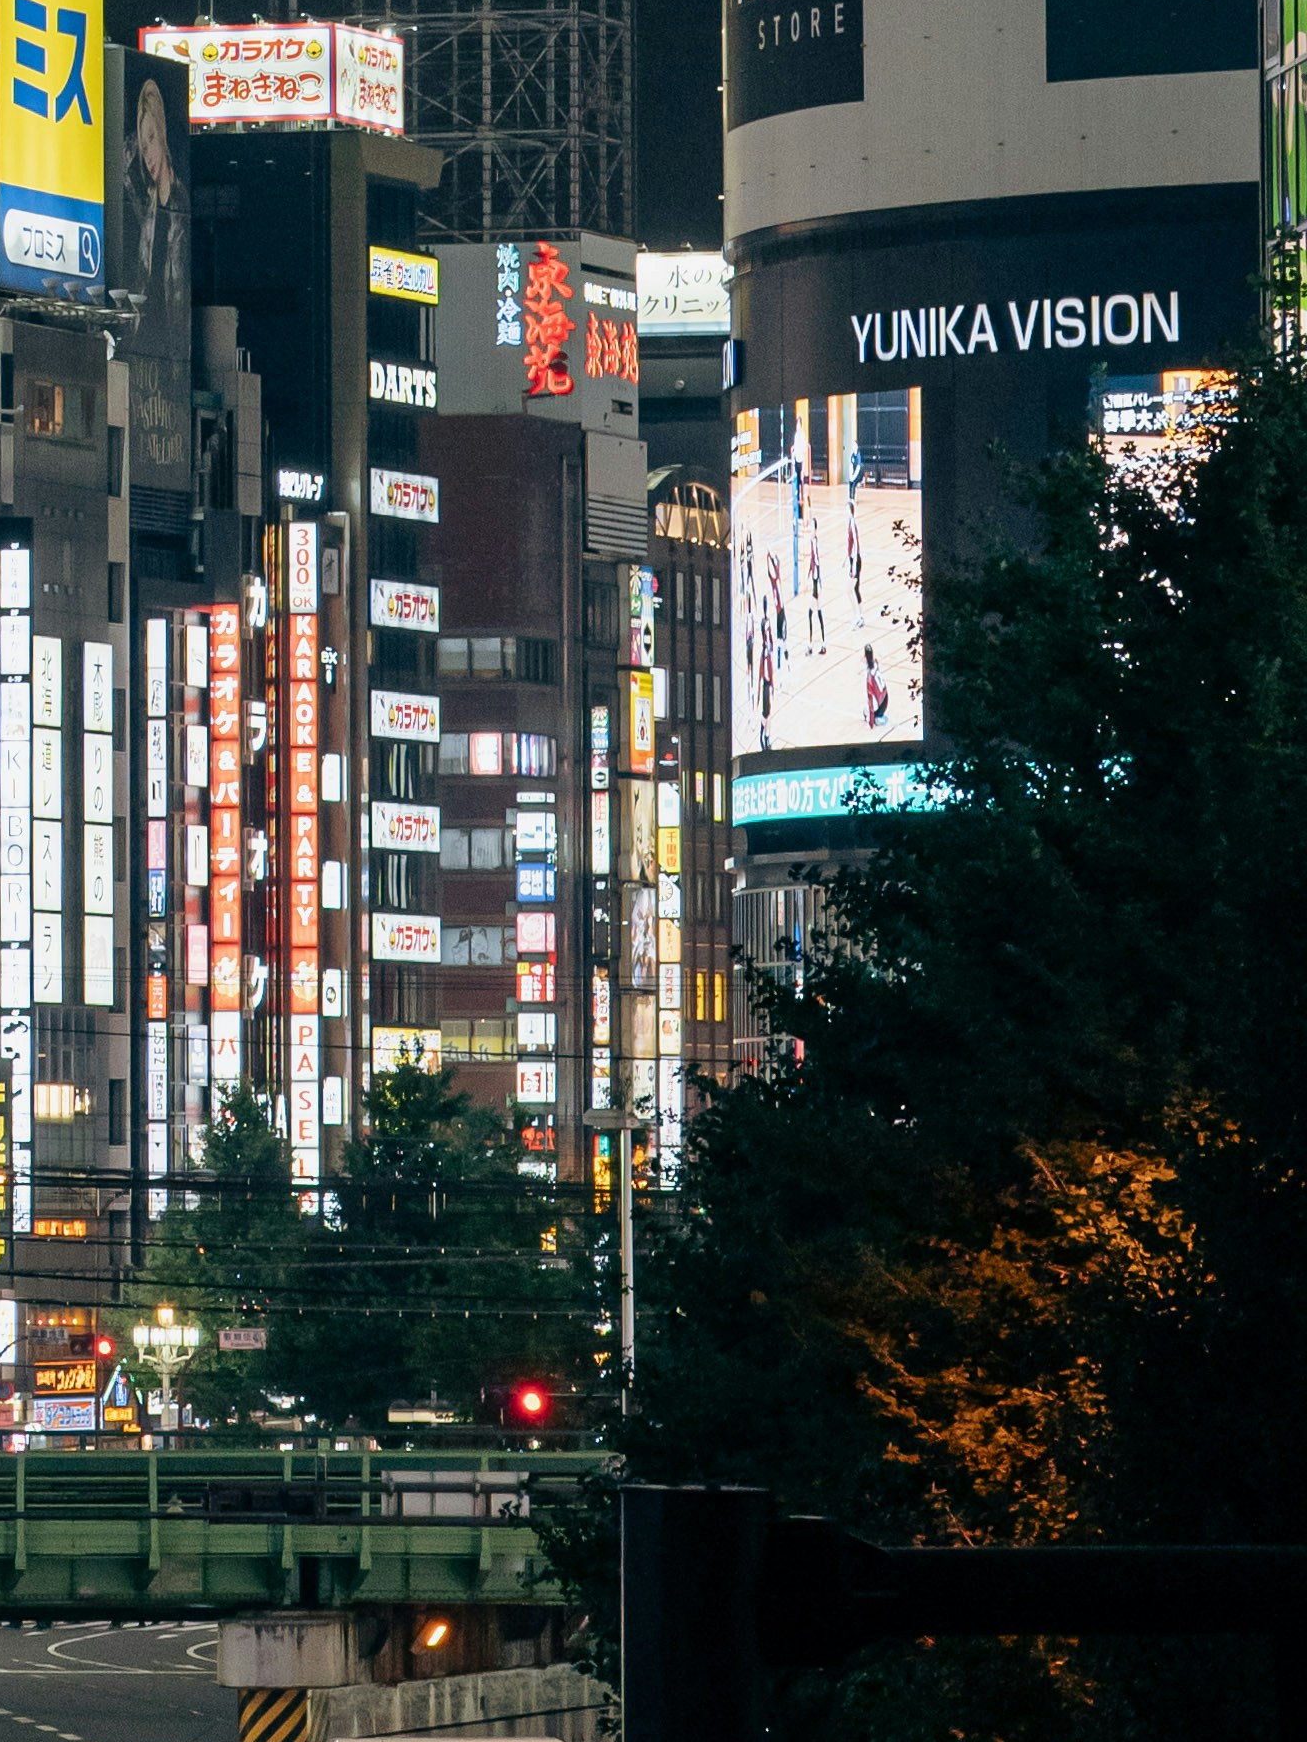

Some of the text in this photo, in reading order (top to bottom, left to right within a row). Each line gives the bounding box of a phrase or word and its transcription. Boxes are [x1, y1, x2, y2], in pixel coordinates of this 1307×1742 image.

[758, 2, 845, 50] STORE
[220, 38, 304, 61] カラオケ
[364, 47, 394, 70] カラオケ
[202, 71, 324, 107] まねきねこ
[358, 77, 397, 115] まねきねこ
[20, 225, 67, 264] プロミス
[371, 254, 436, 297] 麻雀 ウェルカム
[851, 291, 1179, 363] YUNIKA VISION
[370, 361, 436, 408] DARTS
[393, 480, 429, 511] カラオケ
[296, 528, 310, 585] 300
[292, 595, 313, 608] OK
[395, 590, 429, 620] カラオケ
[296, 615, 313, 773] KARAOKE
[396, 700, 431, 731] カラオケ
[396, 812, 431, 844] カラオケ
[296, 816, 314, 926] PARTY
[396, 924, 432, 957] カラオケ
